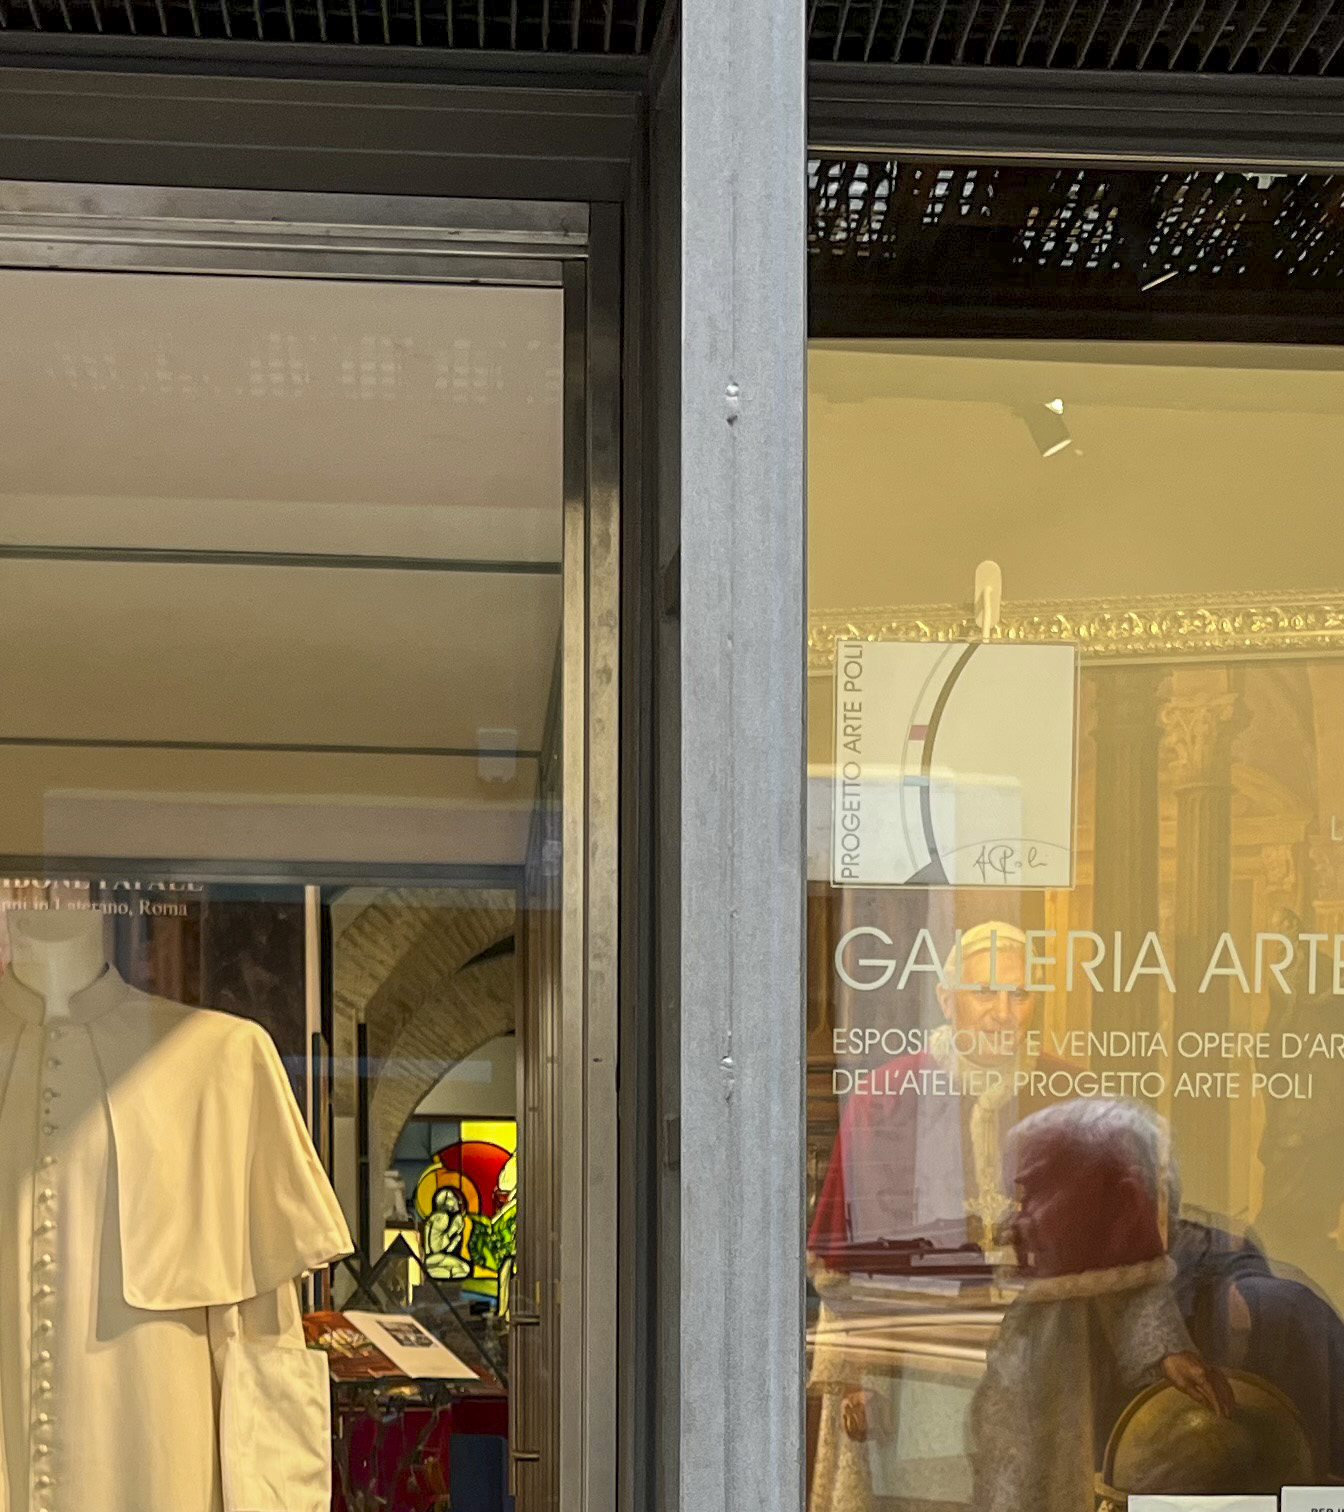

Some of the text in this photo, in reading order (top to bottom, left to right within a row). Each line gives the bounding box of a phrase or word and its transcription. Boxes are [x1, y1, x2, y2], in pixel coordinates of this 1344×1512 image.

[841, 644, 863, 879] PROGETTO ARTE POLI
[834, 926, 1176, 994] GALLERIA
[1027, 1031, 1040, 1056] E
[1051, 1031, 1169, 1057] VENDITA
[1178, 1032, 1270, 1059] OPERE
[832, 1068, 1312, 1099] DELL'ATELIER PROGETTO ARTE POLI
